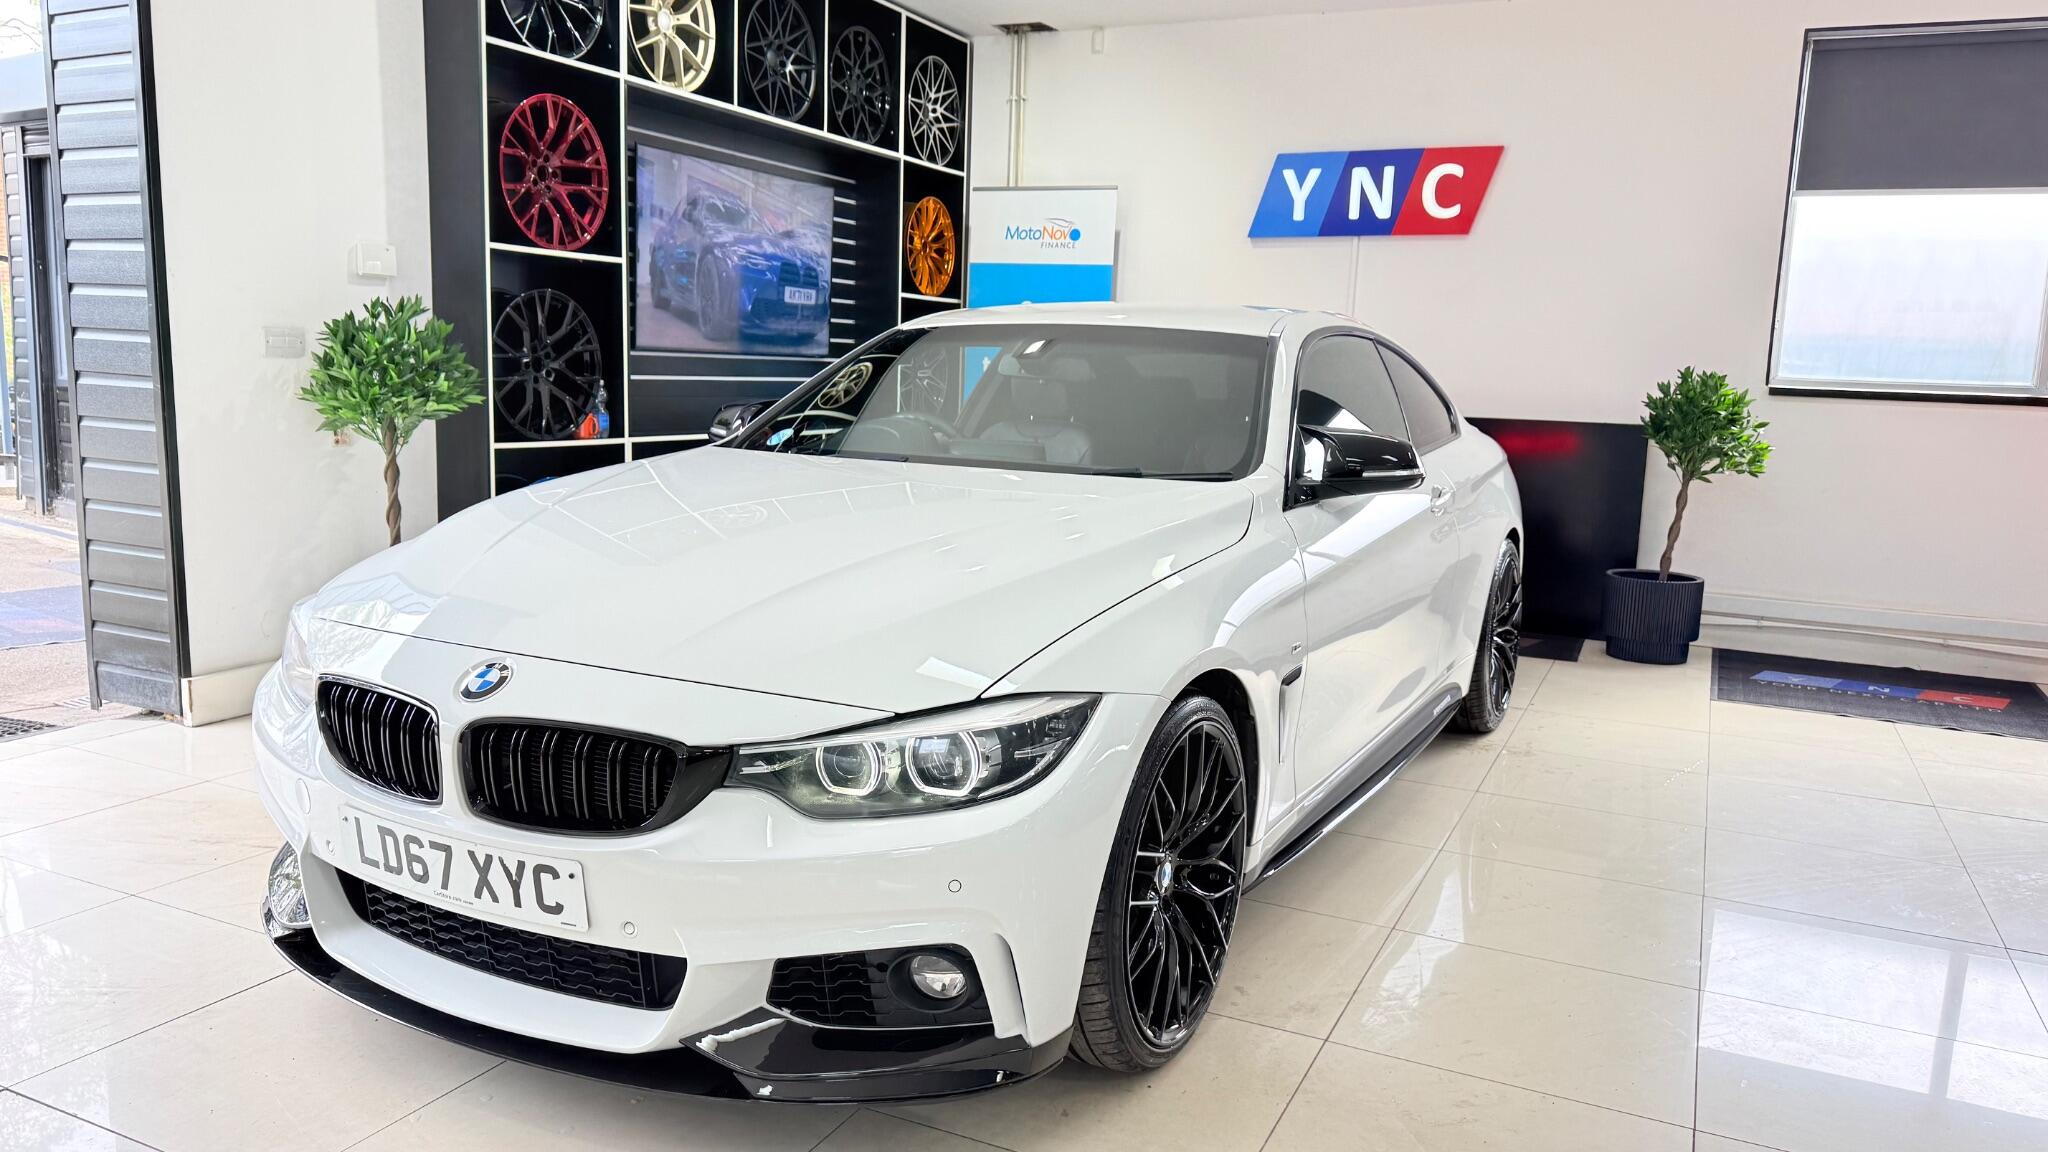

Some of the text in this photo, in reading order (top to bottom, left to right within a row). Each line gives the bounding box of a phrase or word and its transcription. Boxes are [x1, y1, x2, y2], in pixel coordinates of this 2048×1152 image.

[1282, 162, 1464, 221] YNC
[1005, 224, 1081, 242] MotoNovo
[1040, 241, 1077, 249] FINANCE
[354, 816, 564, 915] LD67 XYC
